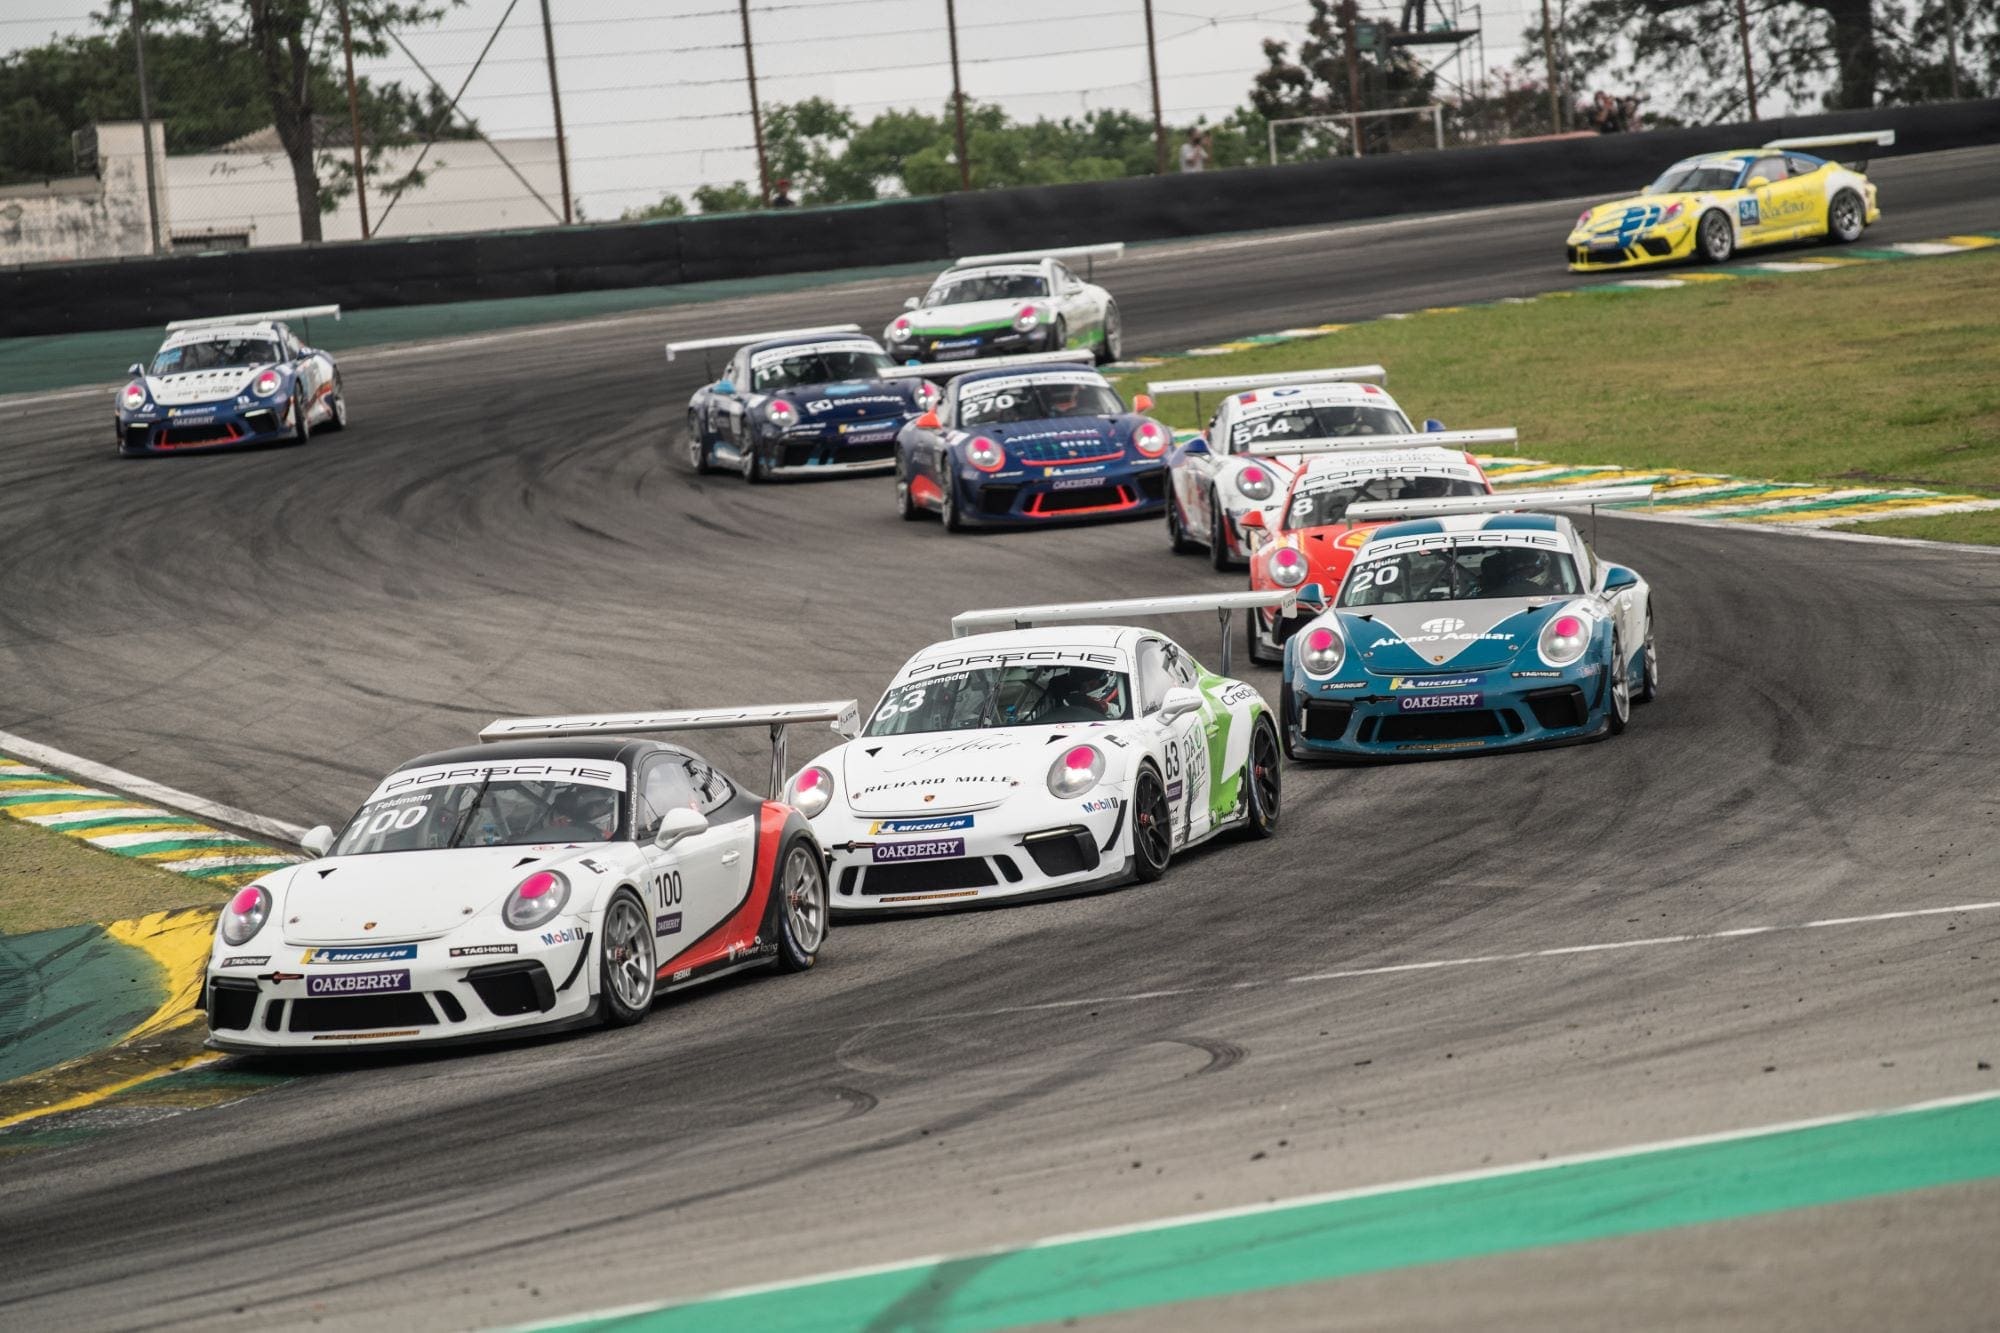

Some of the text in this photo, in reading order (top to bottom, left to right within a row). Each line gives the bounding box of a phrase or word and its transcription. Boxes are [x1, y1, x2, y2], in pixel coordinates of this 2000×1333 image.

[1741, 201, 1757, 219] 34
[961, 395, 1015, 419] 270
[1233, 419, 1292, 445] 544
[1304, 466, 1470, 486] PORSCHE
[1293, 498, 1314, 516] 8
[1368, 535, 1559, 556] PORSCHE
[1351, 566, 1399, 593] 20
[1446, 631, 1515, 643] Aguiar
[908, 651, 1117, 678] PORSCHE
[1417, 677, 1478, 687] MICHELIN
[875, 690, 926, 722] 63
[1402, 693, 1479, 710] OAKBERRY
[1164, 741, 1180, 780] 63
[385, 765, 613, 793] PORSCHE
[865, 775, 1012, 793] RICHARD MILLE
[1082, 799, 1111, 814] Mobil
[351, 805, 429, 841] 100
[897, 819, 967, 832] MICHELIN
[876, 840, 961, 859] OAKBERRY
[655, 870, 682, 908] 100
[541, 928, 575, 946] Mobil
[332, 950, 408, 962] MICHELIN
[312, 973, 405, 992] OAKBERRY
